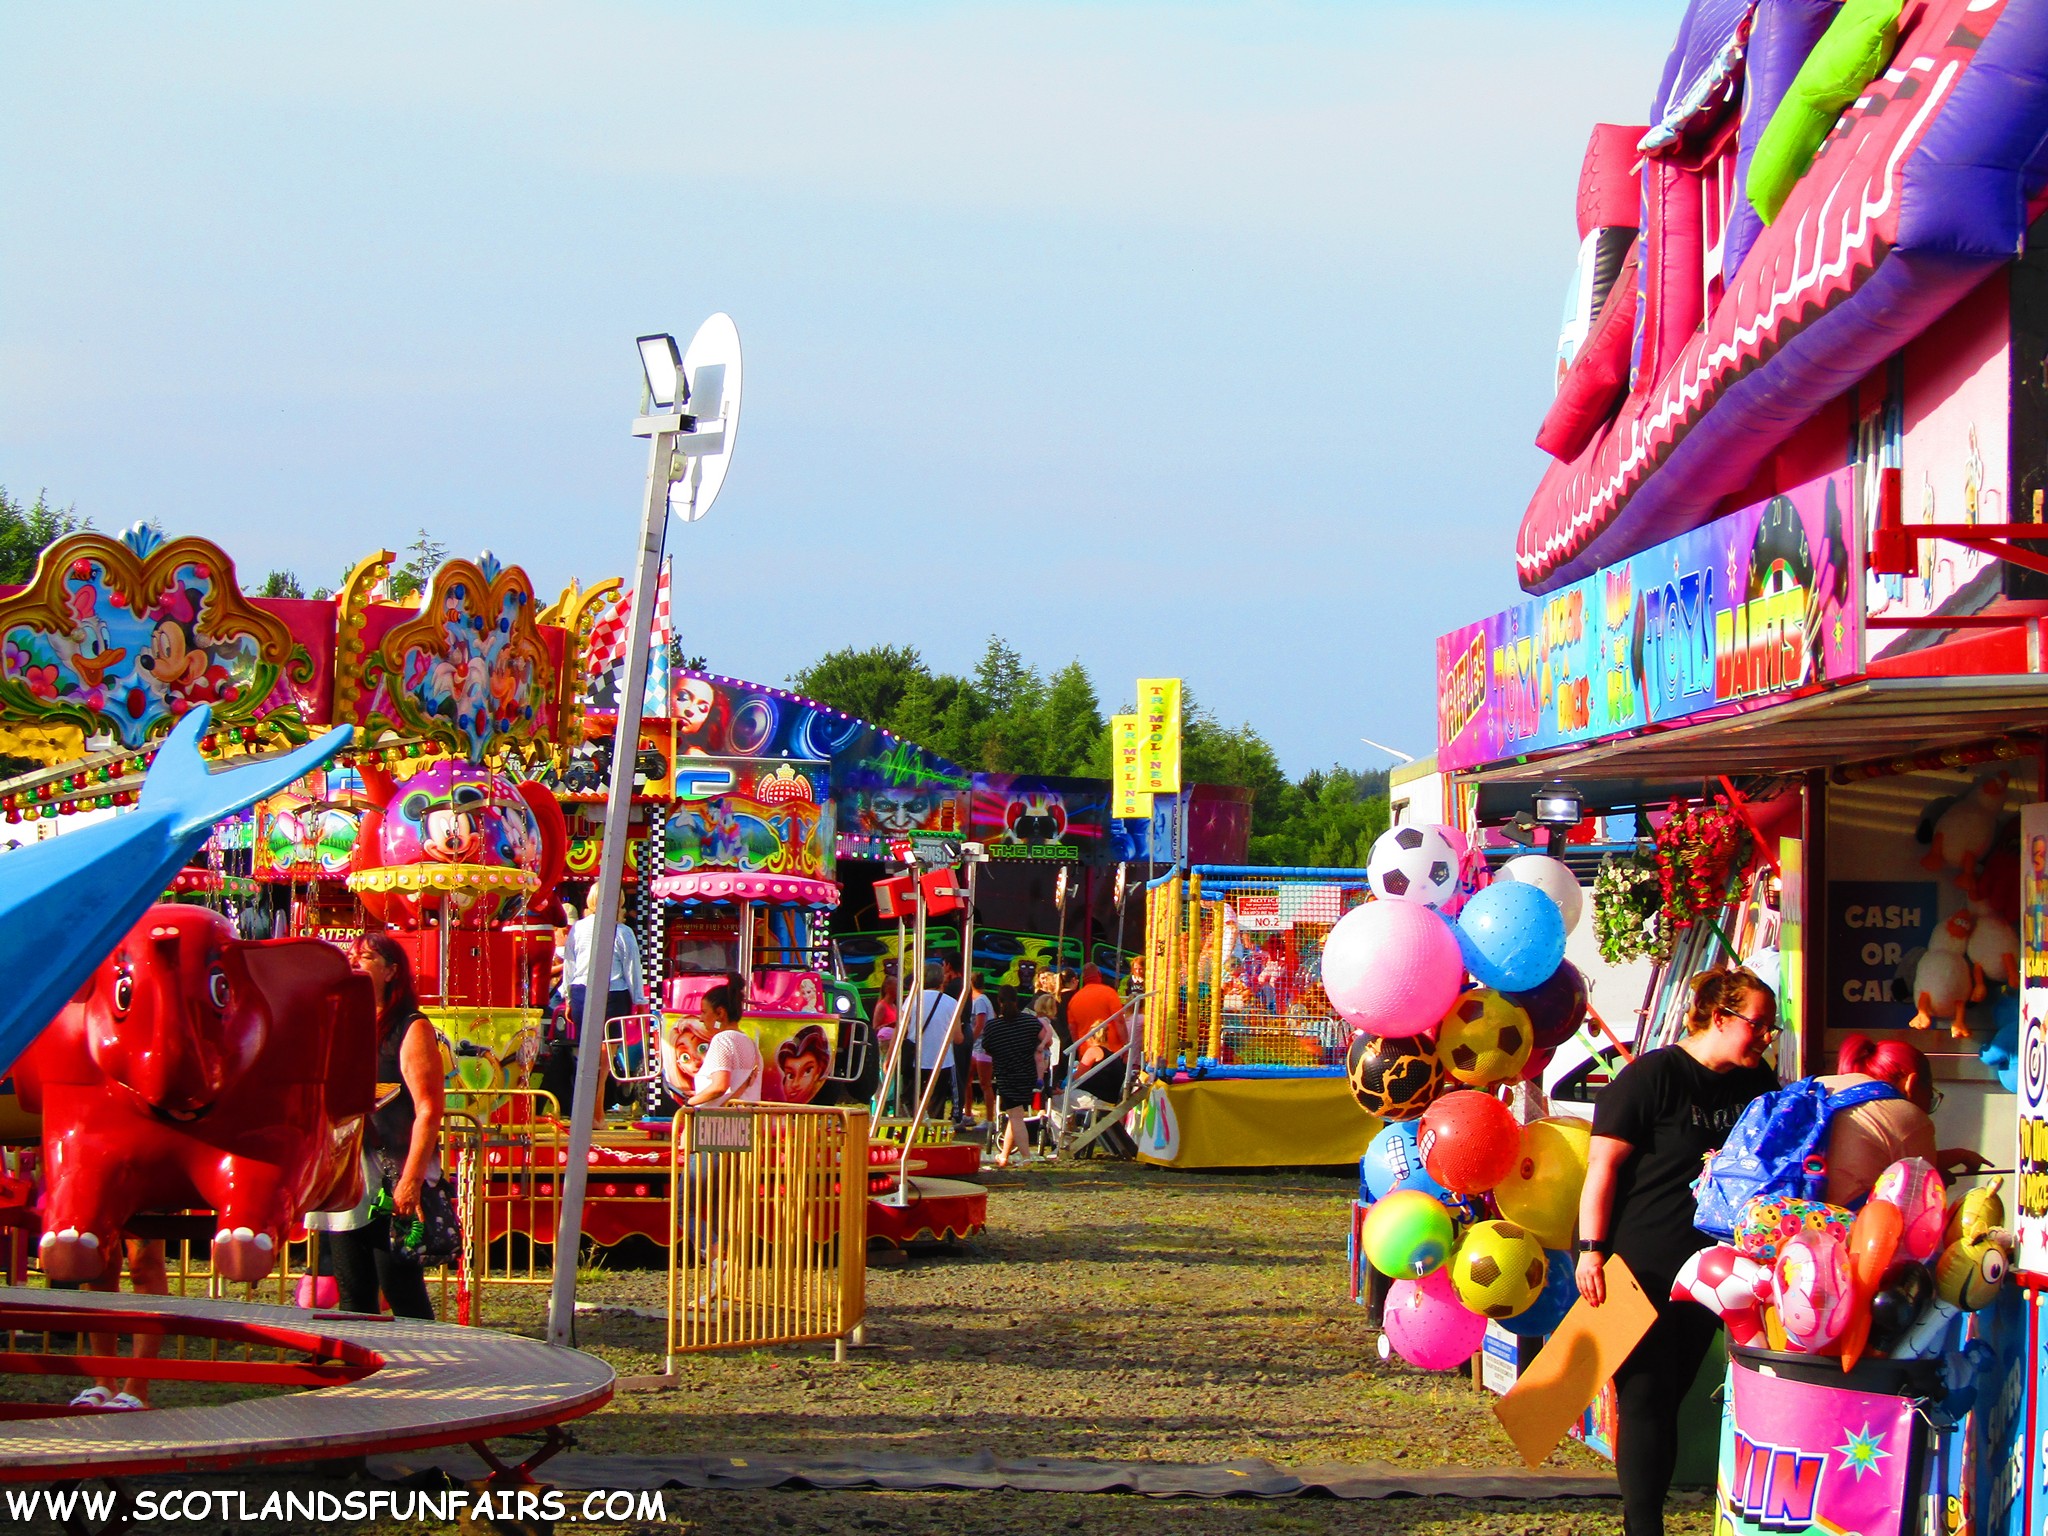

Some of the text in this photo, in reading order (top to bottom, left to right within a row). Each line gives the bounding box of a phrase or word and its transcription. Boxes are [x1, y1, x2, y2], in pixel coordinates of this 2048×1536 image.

[1760, 515, 1767, 544] 5
[1772, 498, 1782, 527] 20
[1787, 505, 1794, 533] 1
[1799, 529, 1809, 568] 18
[1549, 588, 1584, 651] HOOK
[1646, 566, 1714, 712] TOYS
[1715, 584, 1806, 704] DARTS
[1446, 629, 1487, 747] RIFLES
[1493, 632, 1540, 756] TOYS
[1557, 674, 1591, 736] DUCK
[1149, 686, 1164, 788] TRAMPOLINES
[1123, 722, 1137, 814] TRAMPOLINES
[989, 844, 1078, 859] THE DOGS
[1255, 918, 1280, 927] NO.2
[1845, 905, 1921, 929] CASH
[1861, 942, 1902, 966] OR
[1842, 978, 1897, 1003] CAR
[698, 1115, 751, 1147] ENTRANCE
